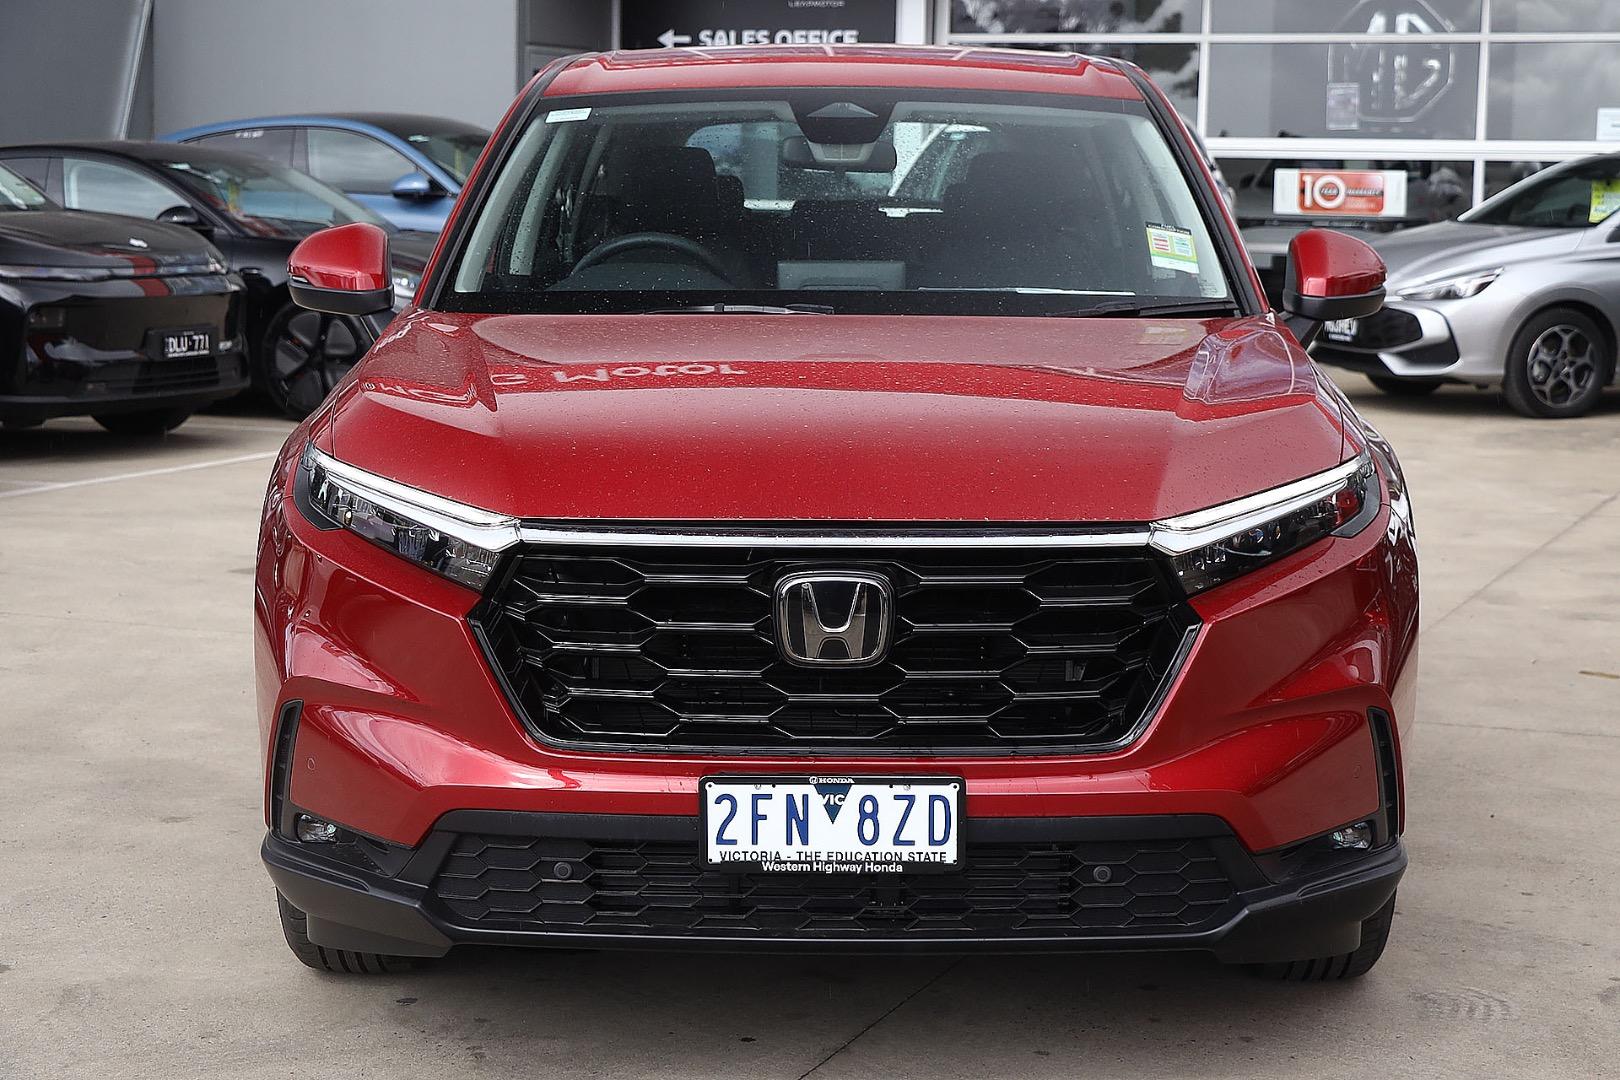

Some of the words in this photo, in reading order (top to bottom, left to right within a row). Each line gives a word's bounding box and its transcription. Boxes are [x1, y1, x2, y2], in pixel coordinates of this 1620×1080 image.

[699, 29, 770, 46] SALES
[775, 29, 859, 45] OFFICE
[1302, 174, 1346, 209] 10
[822, 794, 846, 806] VIC
[714, 793, 809, 846] 2FN
[857, 794, 952, 846] 8ZD
[720, 850, 782, 863] VICTORIA
[797, 850, 824, 863] THE
[827, 850, 903, 863] EDUCATION
[908, 850, 947, 863] STATE
[762, 861, 811, 872] Western
[813, 861, 862, 874] Highway
[865, 861, 903, 873] Honda
